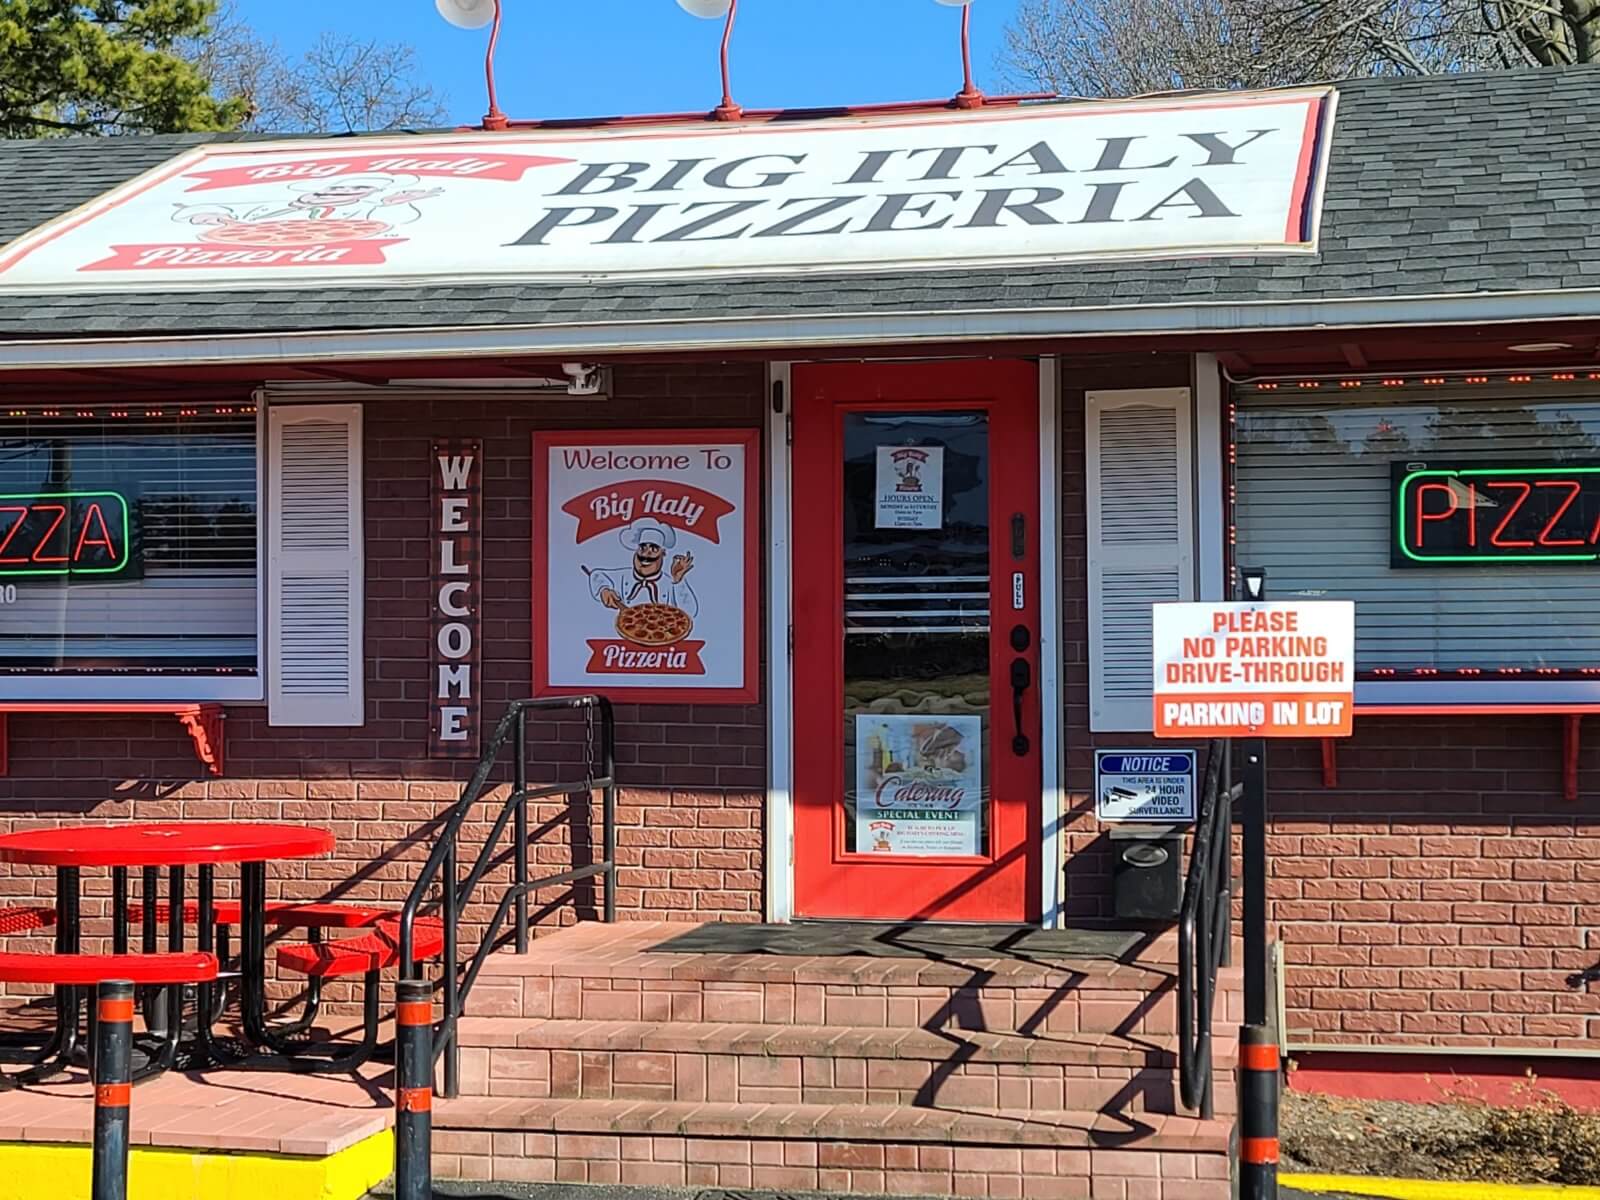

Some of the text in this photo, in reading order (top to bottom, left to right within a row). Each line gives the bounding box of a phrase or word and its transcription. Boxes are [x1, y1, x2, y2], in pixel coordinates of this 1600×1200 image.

[247, 157, 507, 180] Big Italy
[543, 128, 1279, 197] BIG ITALY
[499, 176, 1243, 248] PIZZERIA
[133, 245, 352, 266] Pizzeria
[563, 449, 732, 470] Welcome To
[590, 490, 705, 526] Big Italy
[437, 455, 474, 741] WELCOME
[1213, 612, 1299, 633] PLEASE
[603, 645, 688, 669] Pizzeria
[1183, 636, 1328, 658] NO PARKING
[1166, 661, 1345, 684] DRIVE-THROUGH
[1163, 702, 1344, 726] PARKING IN LOT
[1120, 757, 1171, 772] NOTICE
[1121, 776, 1137, 784] THIS
[1137, 776, 1154, 784] AREA
[1162, 776, 1185, 784] UNDER
[1145, 785, 1185, 795] 24 HOUR
[876, 776, 965, 809] Catering
[1151, 796, 1180, 806] VIDEO
[877, 811, 959, 820] SPECIAL EVENT
[1128, 807, 1185, 816] SURVEILLANCE
